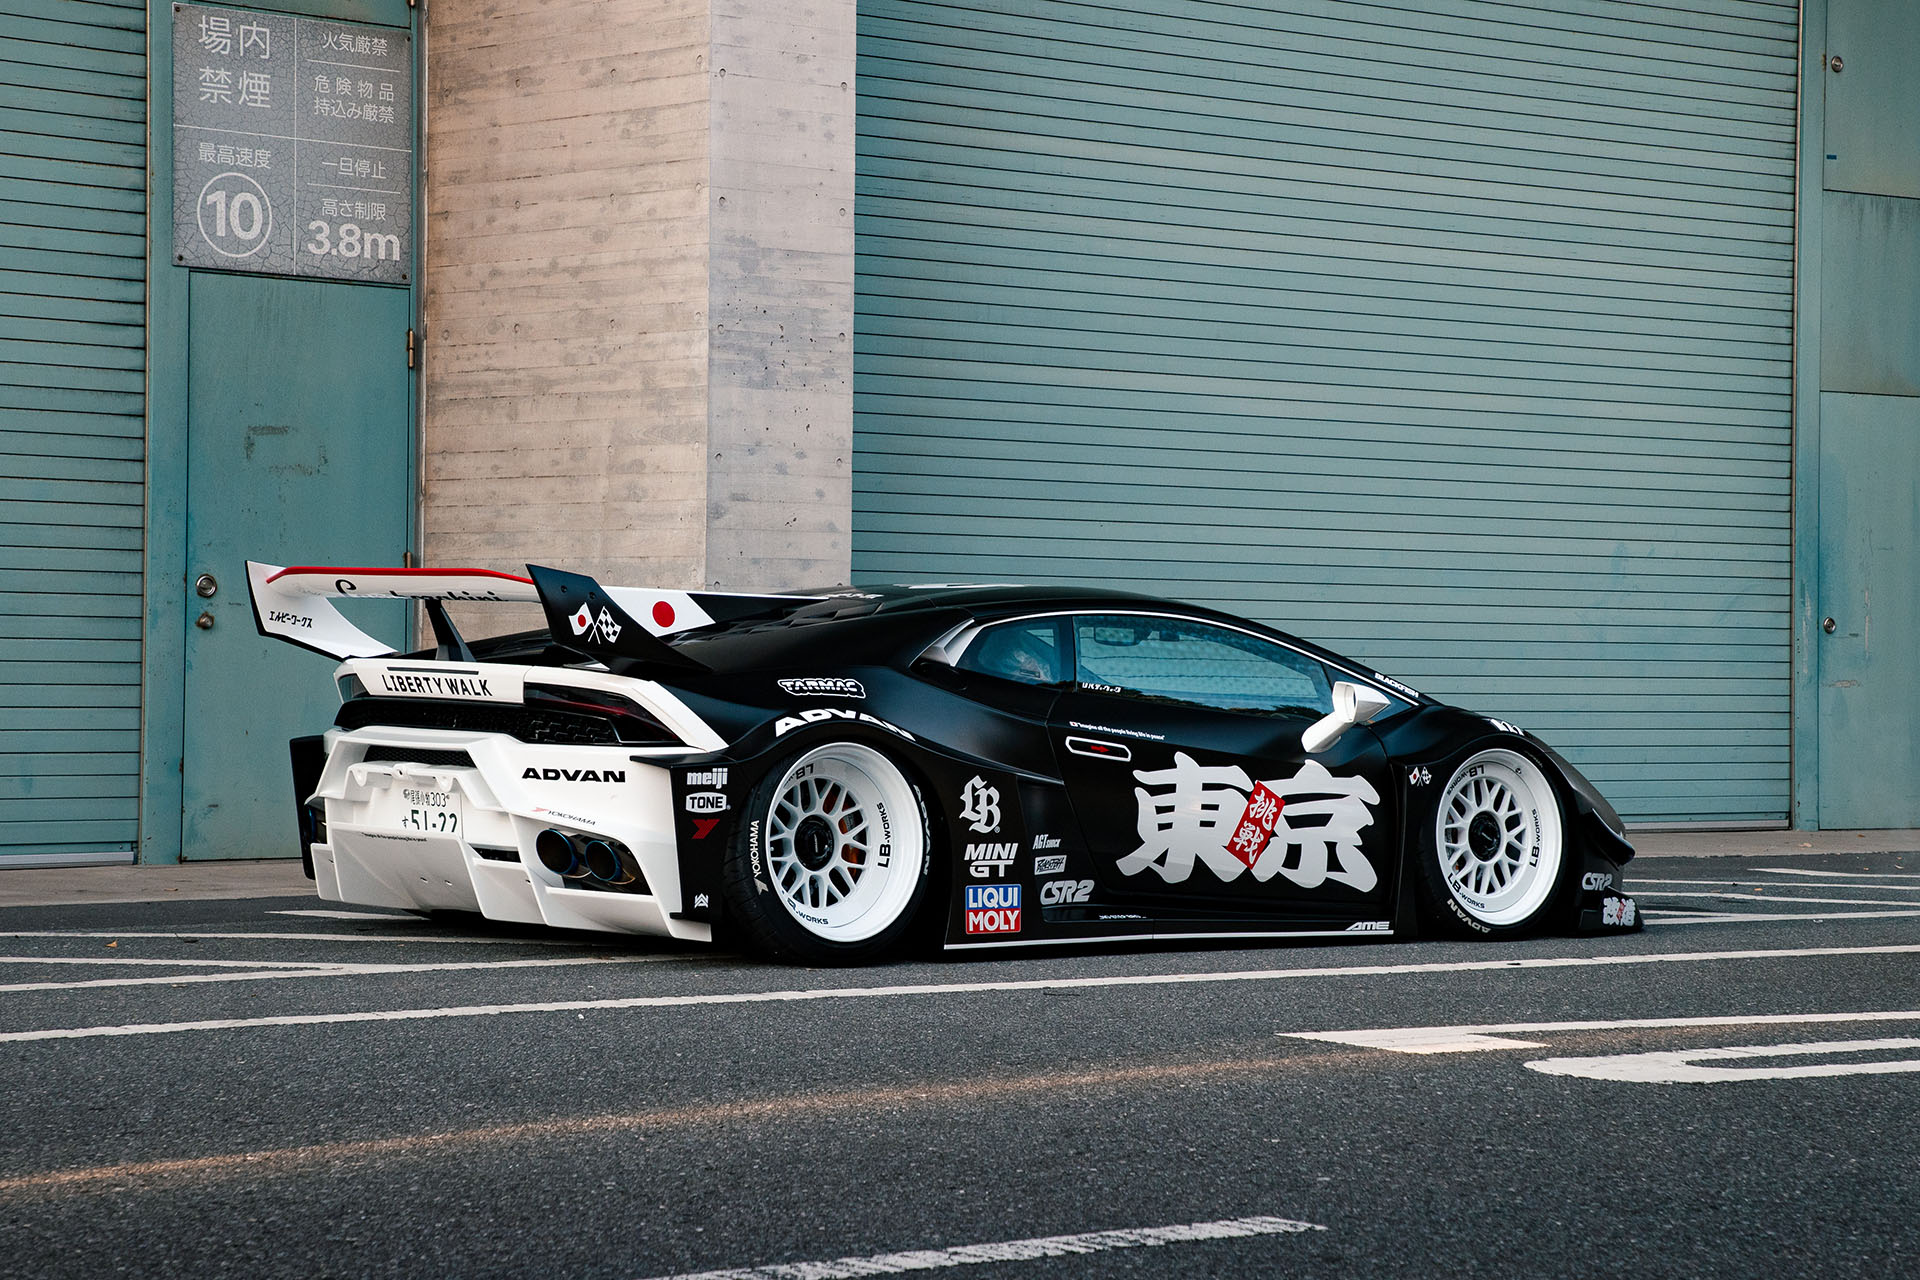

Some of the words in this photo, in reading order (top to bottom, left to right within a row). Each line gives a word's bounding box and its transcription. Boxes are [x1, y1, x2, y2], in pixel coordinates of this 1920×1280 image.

[198, 15, 270, 60] 場内
[322, 31, 388, 57] 火気厳禁
[199, 66, 271, 109] 禁煙
[314, 74, 394, 102] 危険物品
[314, 97, 395, 124] 持込み厳禁
[198, 142, 272, 170] 最高速度
[321, 157, 387, 180] 一旦停止
[206, 190, 264, 240] 10
[321, 198, 387, 221] 高さ制限
[307, 220, 400, 261] 3.8m
[381, 674, 443, 695] LIBERTY
[446, 679, 493, 697] WALK
[780, 679, 862, 697] TARMAC
[775, 708, 916, 742] ADVAN
[522, 767, 625, 784] ADVAN
[686, 767, 728, 789] meiji
[689, 796, 724, 810] TONE
[1115, 751, 1381, 893] 東京
[750, 820, 762, 878] YOKOHAMA
[963, 842, 1019, 860] MINI
[969, 860, 1014, 878] GT
[968, 887, 1018, 909] LIQUI
[1040, 879, 1095, 905] CSR2
[968, 910, 1020, 931] MOLY
[1447, 899, 1492, 933] ADVAN
